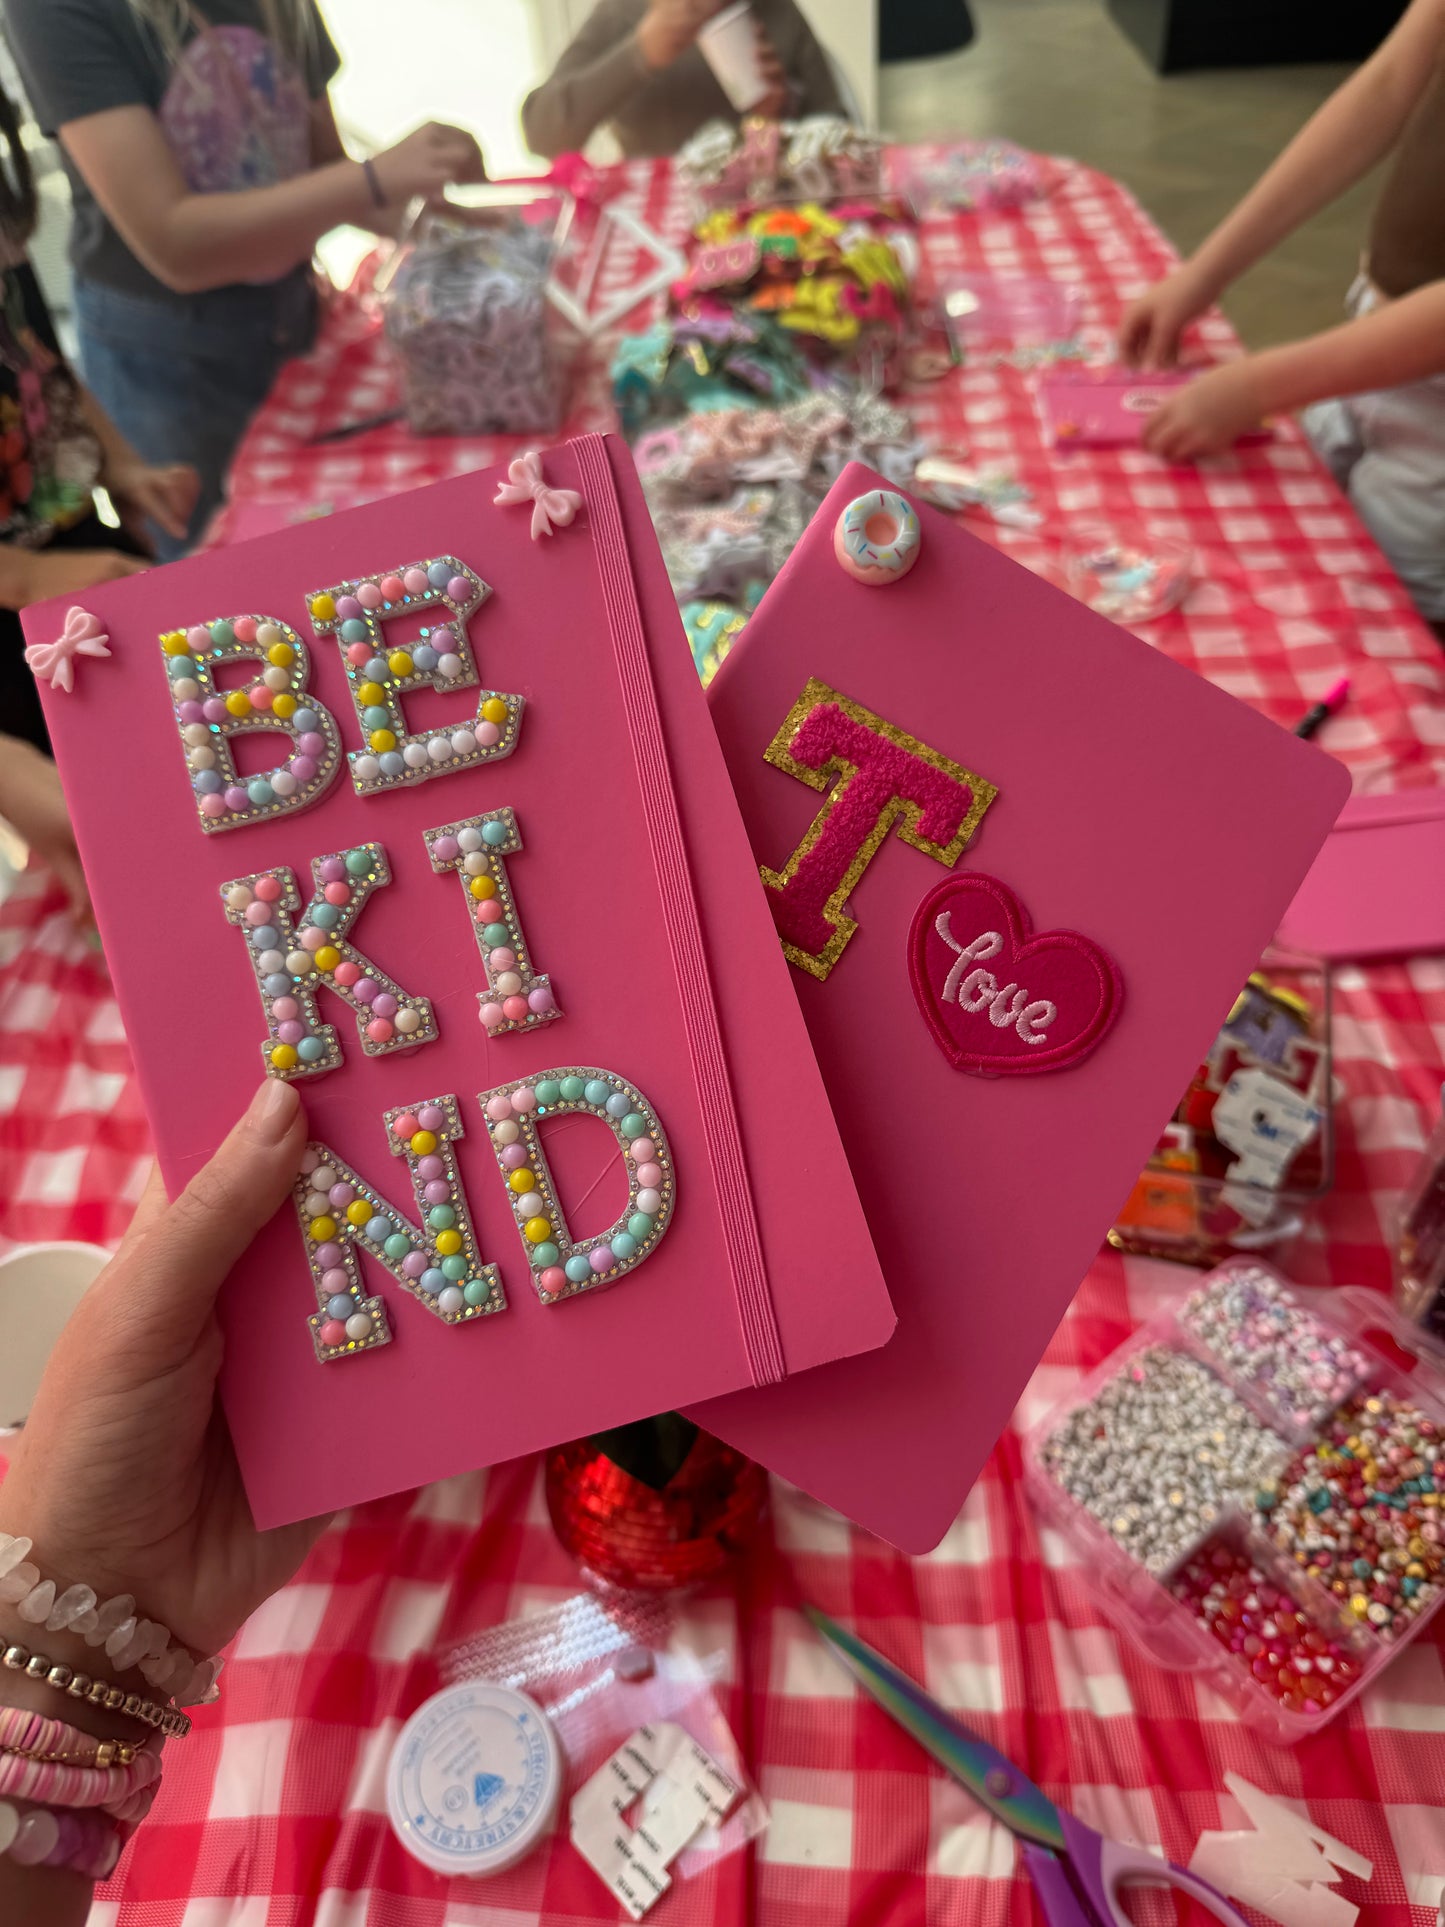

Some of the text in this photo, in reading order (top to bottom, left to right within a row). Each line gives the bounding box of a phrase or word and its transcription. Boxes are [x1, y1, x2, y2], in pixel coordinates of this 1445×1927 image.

[158, 553, 527, 835] BE
[760, 676, 999, 982] T
[935, 911, 1058, 1045] love
